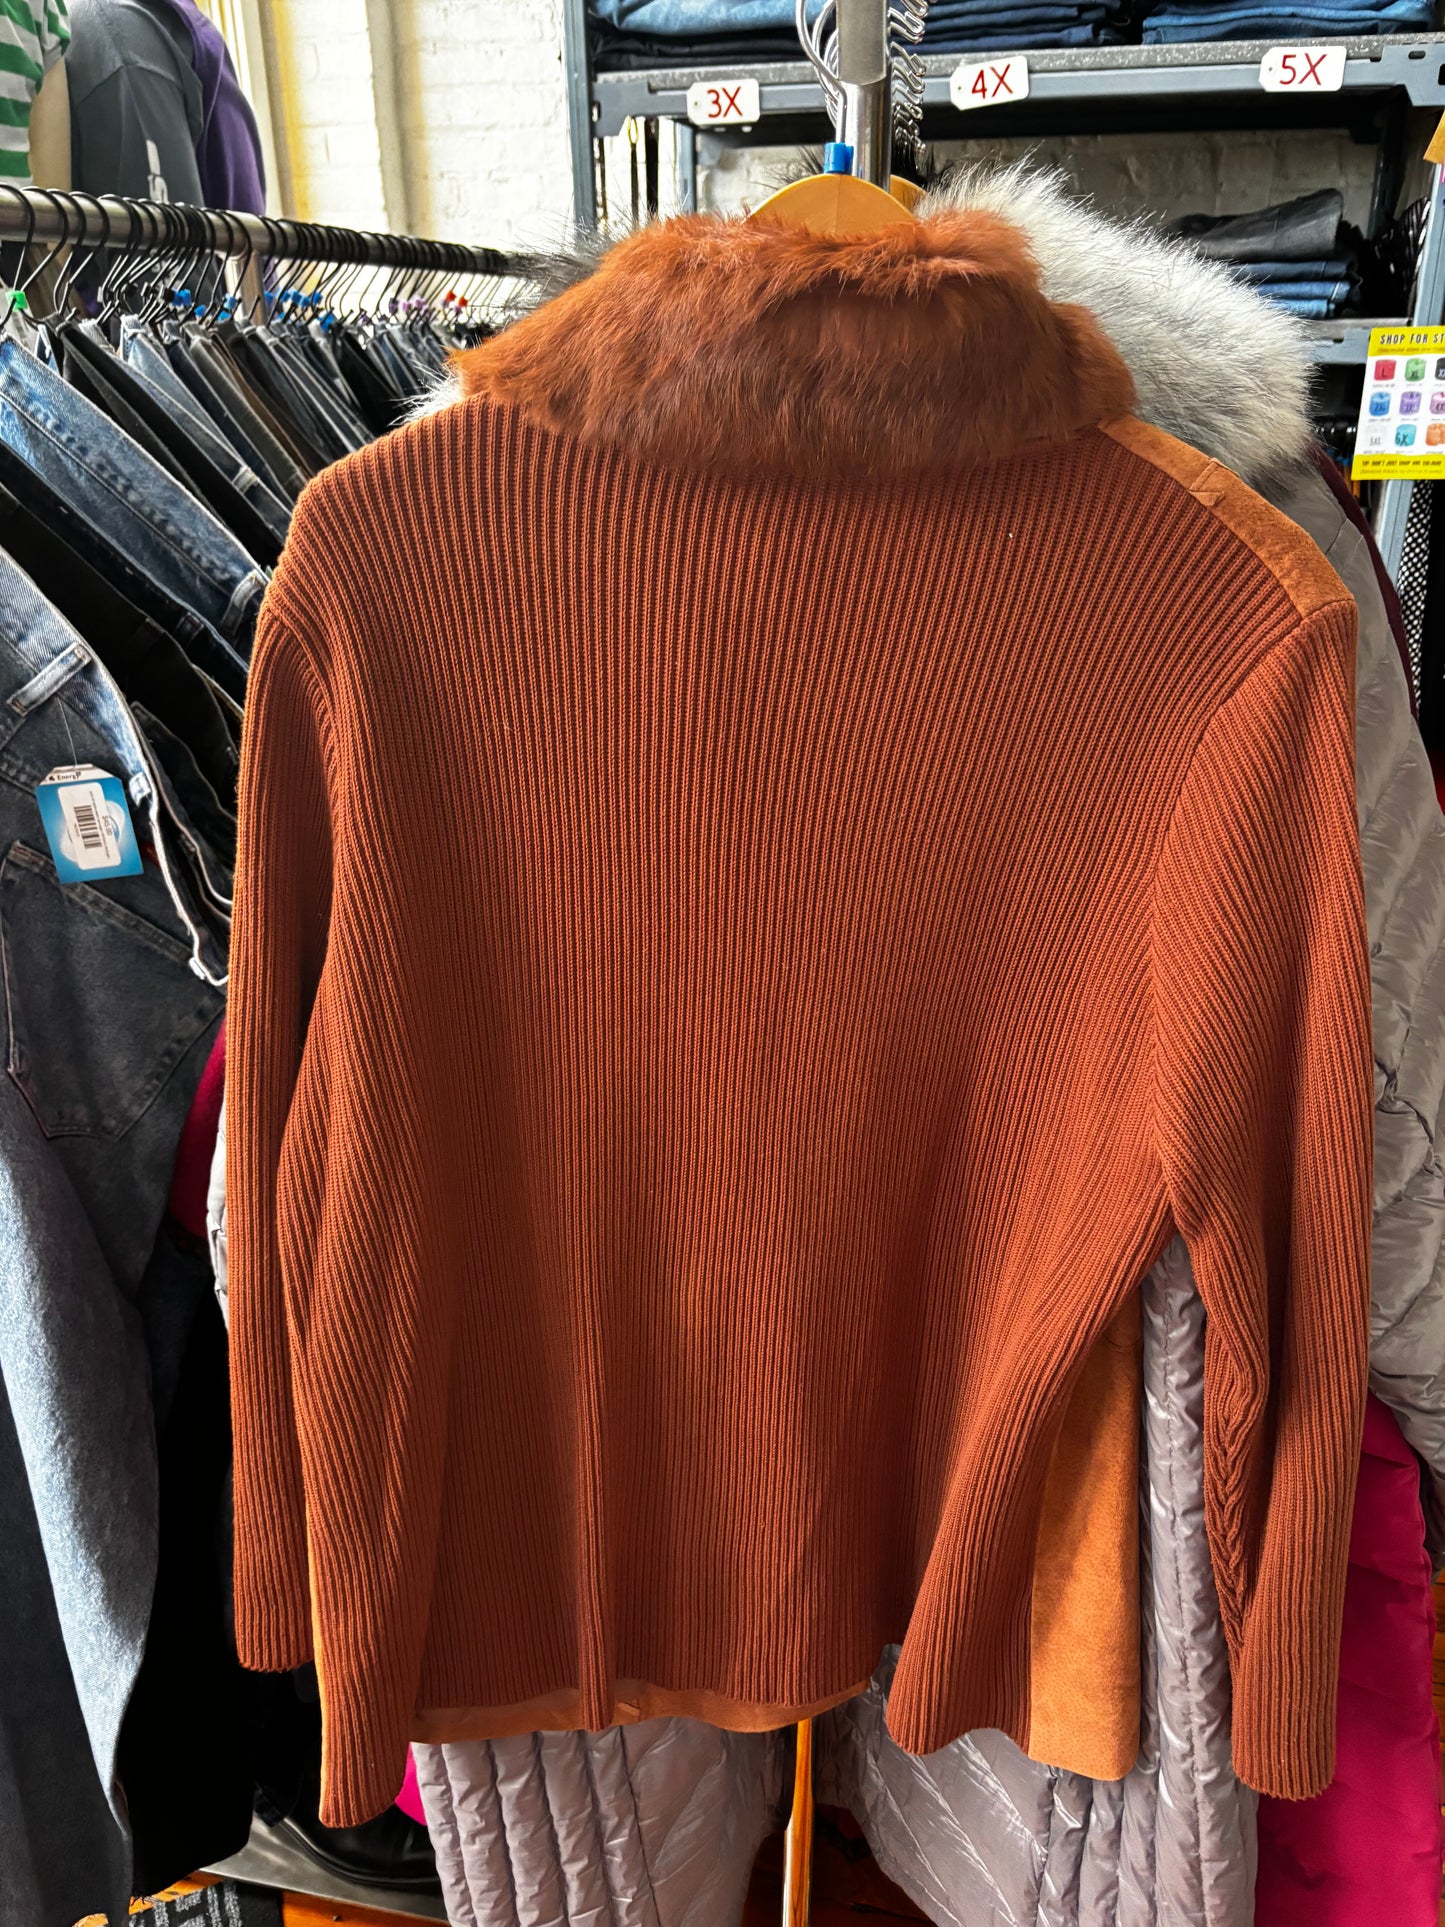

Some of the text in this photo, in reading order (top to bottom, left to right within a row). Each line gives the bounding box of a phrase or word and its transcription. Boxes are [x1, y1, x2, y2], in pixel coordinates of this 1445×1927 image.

[971, 63, 1013, 100] 4X
[1279, 52, 1328, 86] 5X
[707, 86, 743, 118] 3X
[1380, 334, 1405, 345] SHOP
[1410, 333, 1428, 344] FOR
